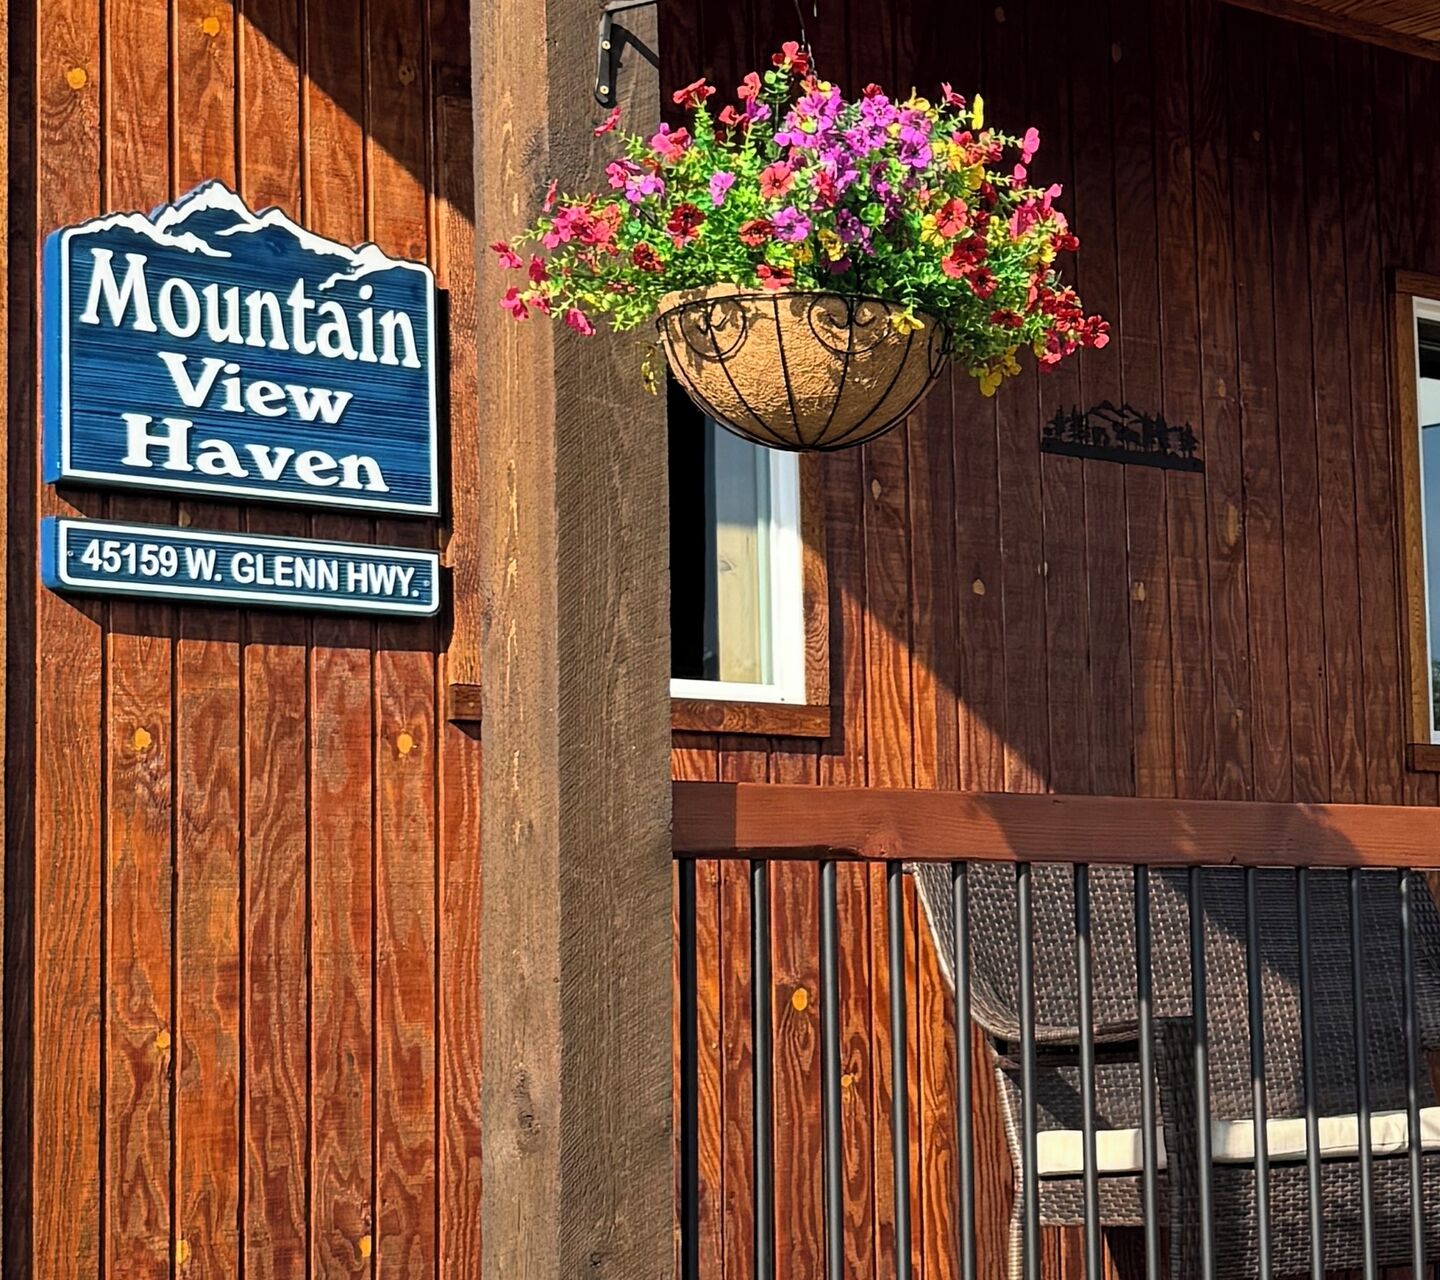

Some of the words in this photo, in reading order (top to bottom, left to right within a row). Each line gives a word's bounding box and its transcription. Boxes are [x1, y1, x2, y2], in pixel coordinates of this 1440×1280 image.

[79, 248, 421, 368] Mountain
[158, 351, 353, 424] View
[121, 413, 389, 493] Haven
[81, 539, 178, 577] 45159
[184, 548, 221, 581] W.
[231, 552, 339, 590] GLENN
[348, 562, 420, 597] HWY.
